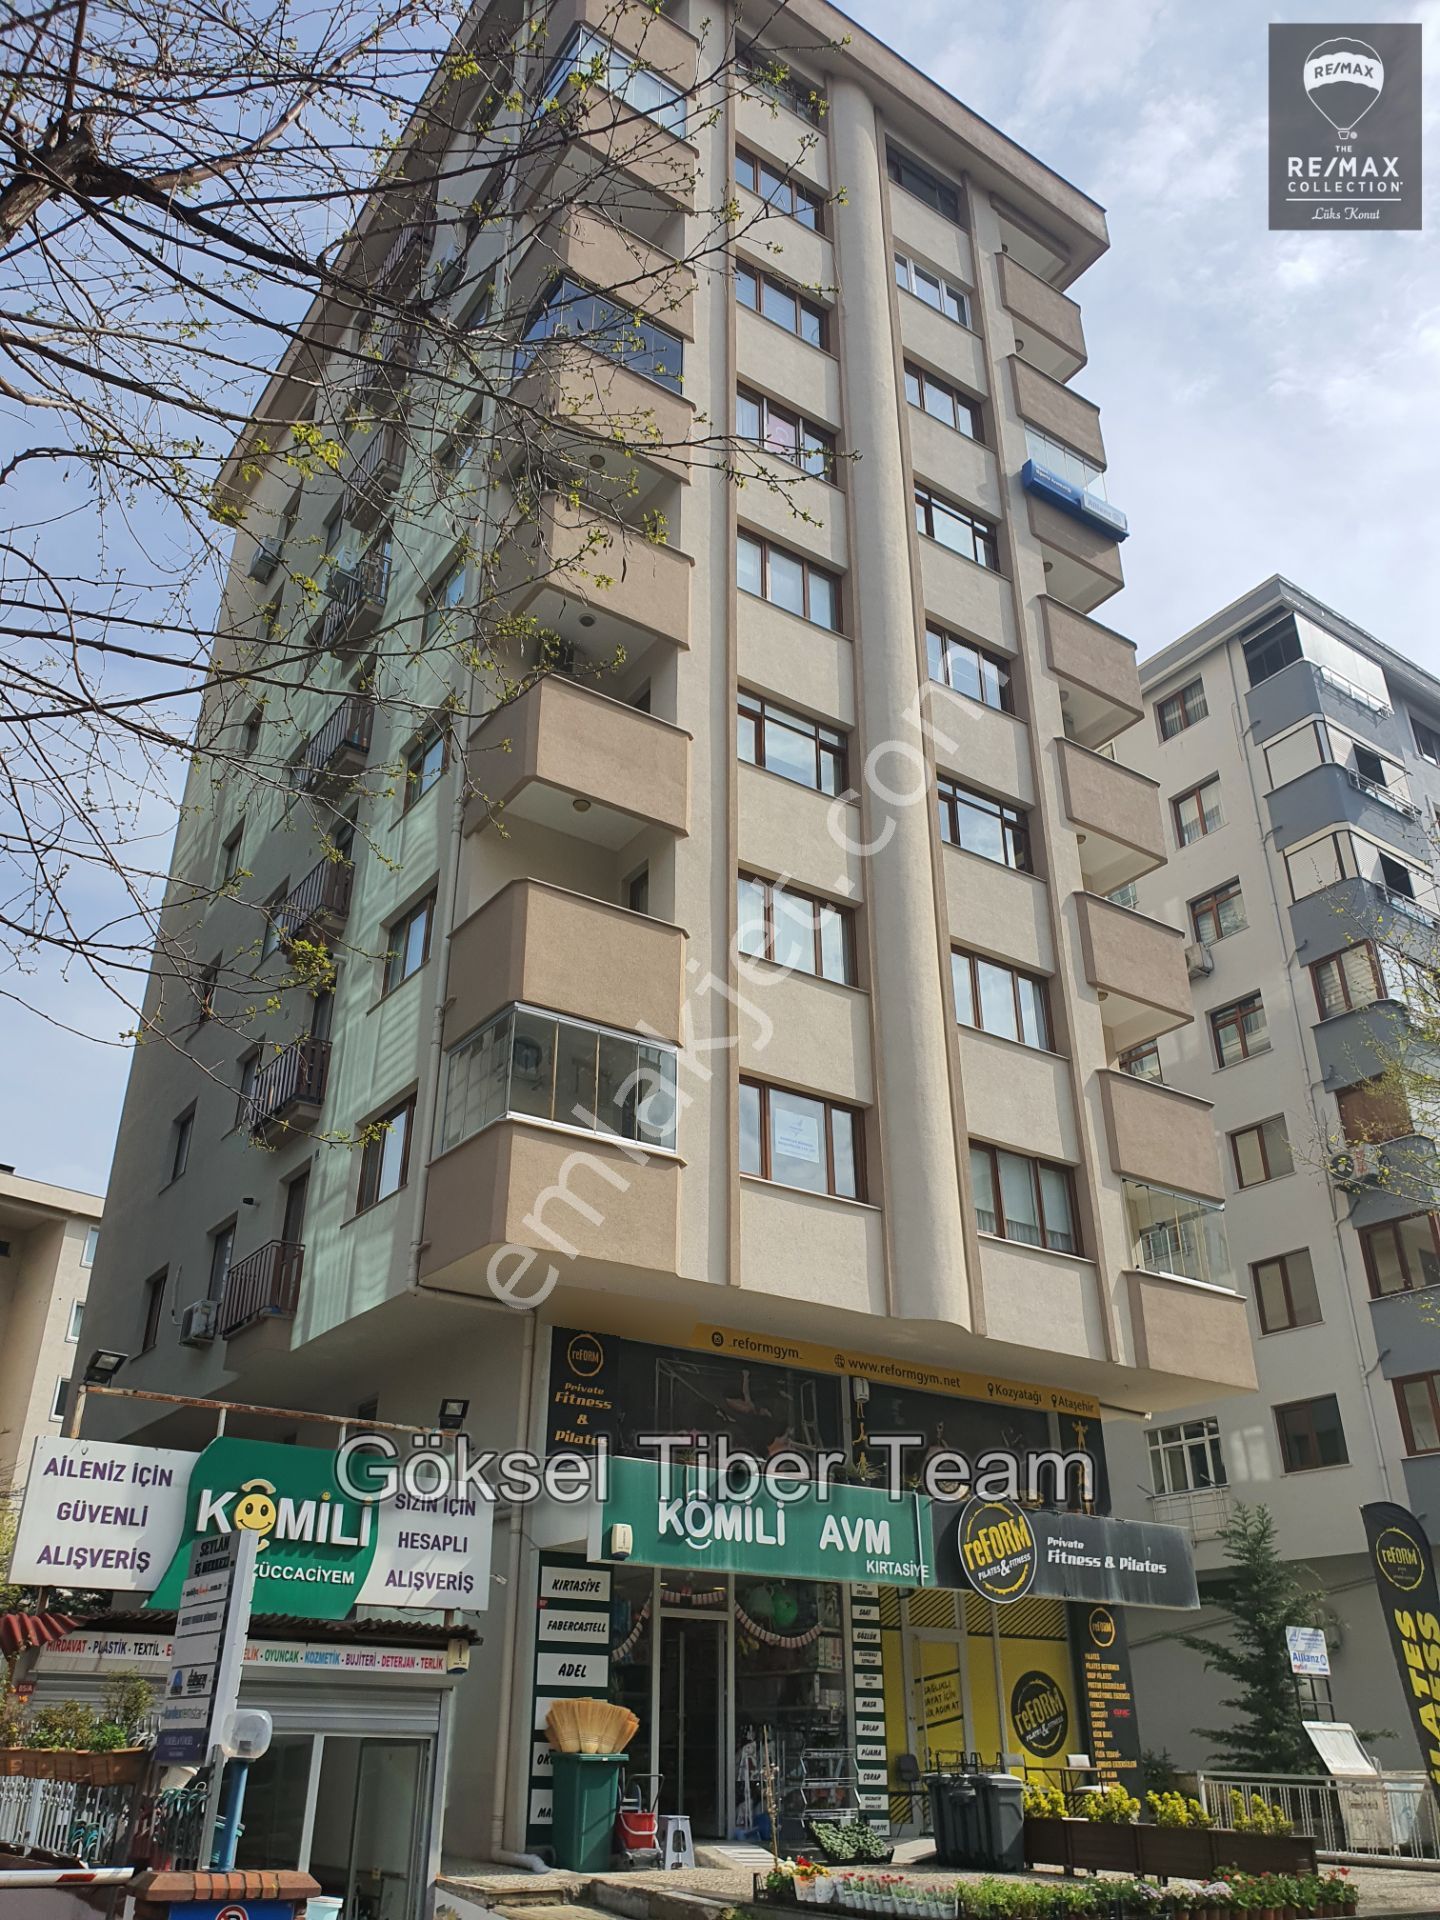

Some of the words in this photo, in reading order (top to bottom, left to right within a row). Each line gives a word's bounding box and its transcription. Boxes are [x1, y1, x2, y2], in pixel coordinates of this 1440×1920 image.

[847, 1358, 961, 1389] www.reformgym.net
[555, 1391, 613, 1409] Fitness
[565, 1382, 605, 1395] Private
[995, 1384, 1042, 1405] Kozyatağı
[1058, 1396, 1095, 1412] Ataşehir
[577, 1414, 589, 1424] &
[43, 1455, 127, 1482] AİLENİZ
[131, 1463, 173, 1487] İÇİN
[57, 1500, 149, 1527] GÜVENLİ
[398, 1531, 468, 1553] HESAPLI
[820, 1514, 891, 1556] AVM
[964, 1515, 1032, 1571] reFORM
[1047, 1536, 1085, 1550] Private
[37, 1545, 151, 1573] ALIŞVERİŞ
[1048, 1550, 1101, 1568] Fitness
[1104, 1556, 1116, 1569] &
[1119, 1556, 1168, 1574] Pilates
[1382, 1546, 1418, 1565] reFORM
[866, 1559, 929, 1579] KIRTASİYE
[385, 1569, 474, 1594] ALIŞVERİŞ
[552, 1578, 601, 1592] KIRTASİYE
[547, 1620, 606, 1632] FABERCASTELL
[133, 1641, 160, 1656] TEXTİL
[264, 1649, 299, 1662] OYUNCAK
[304, 1650, 341, 1664] KOZMETİK
[381, 1656, 415, 1668] DETERJAN
[420, 1655, 443, 1669] TERLİK
[1293, 1651, 1320, 1664] Allianz
[558, 1663, 587, 1678] ADEL
[1015, 1687, 1063, 1735] reFORM
